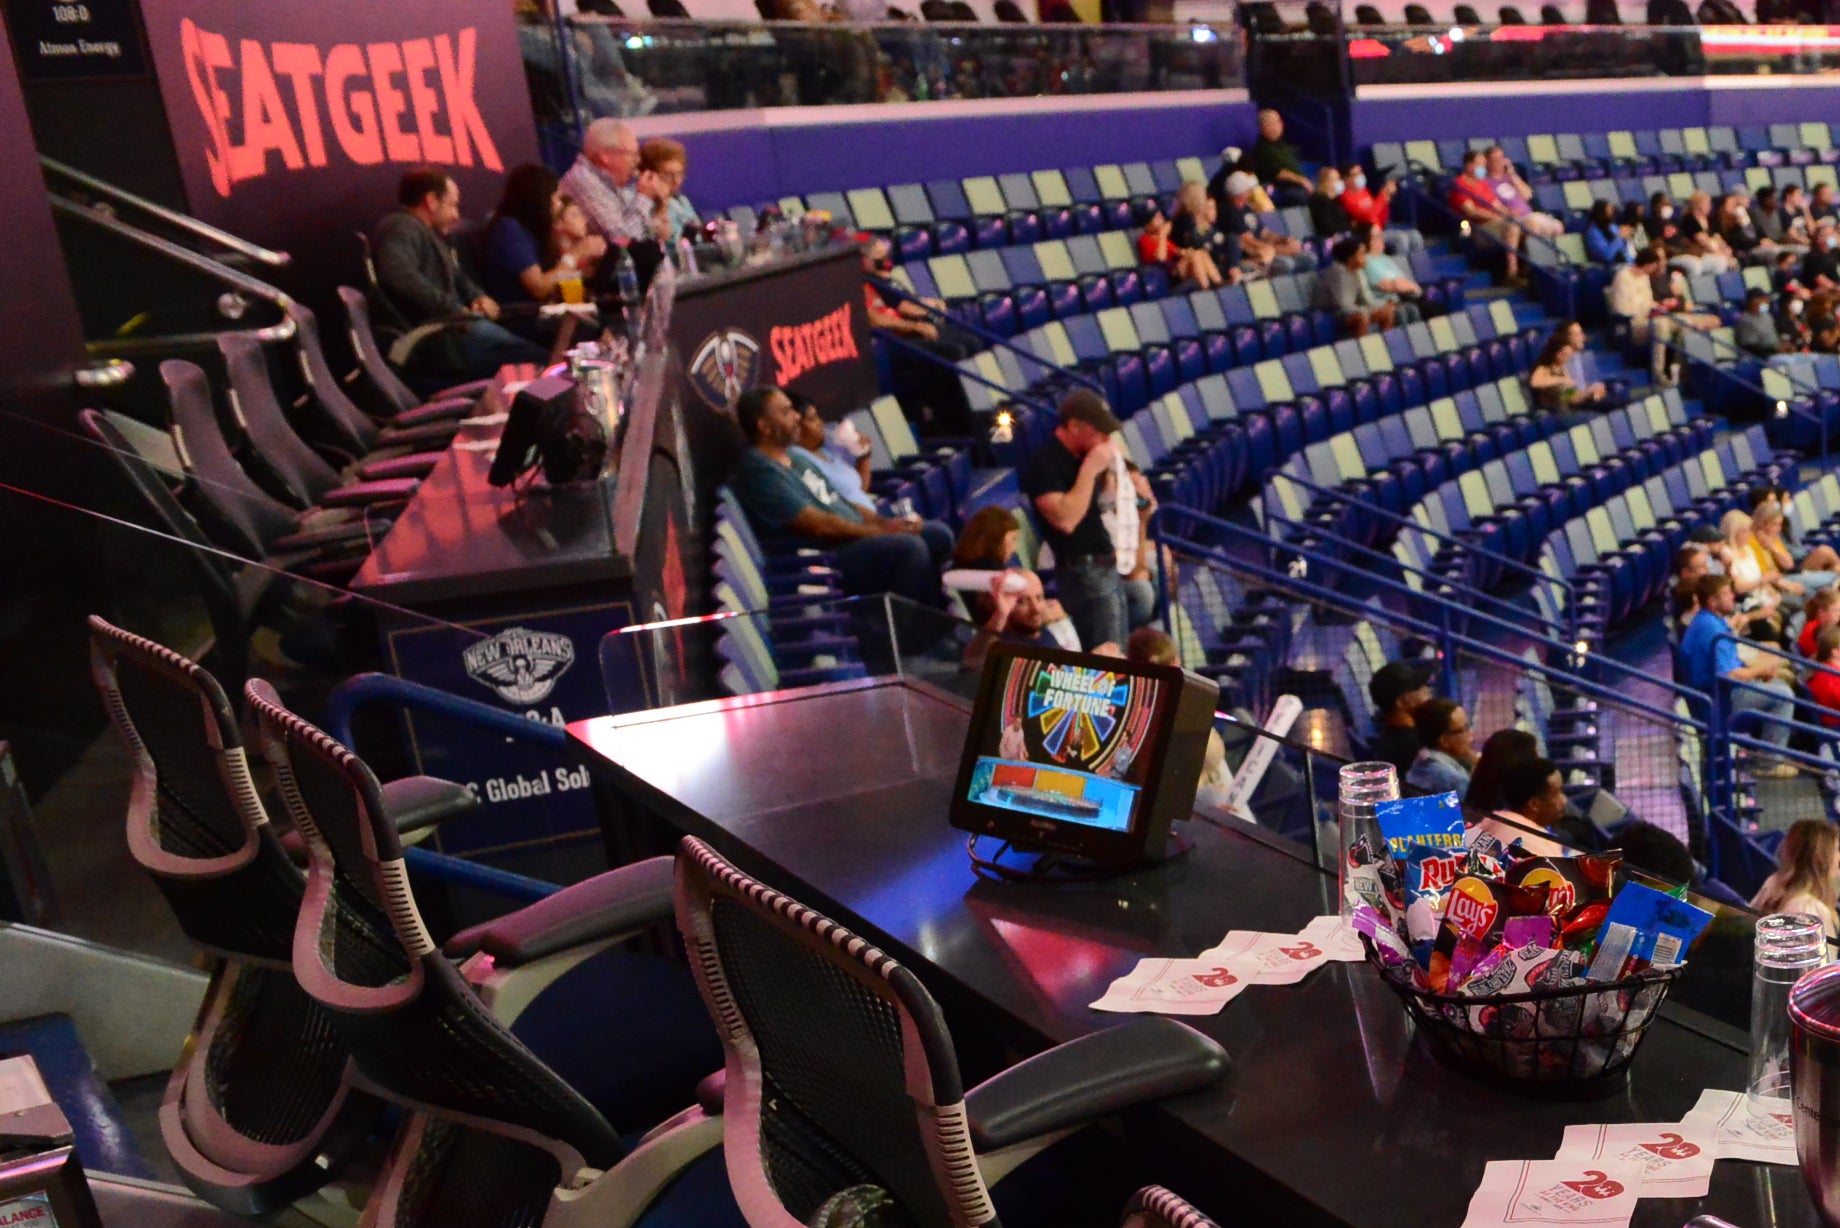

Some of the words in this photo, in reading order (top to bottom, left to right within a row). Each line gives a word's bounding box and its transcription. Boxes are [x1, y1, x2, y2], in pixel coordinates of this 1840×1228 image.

[180, 17, 504, 197] SEATGEEK
[770, 303, 859, 386] SEATGEEK
[466, 640, 501, 674] NEW
[505, 635, 572, 662] ORLEANS
[1050, 669, 1095, 694] WHEEL
[1097, 678, 1116, 698] OF
[1043, 688, 1111, 718] FORTUNE
[486, 770, 551, 804] Global
[1449, 889, 1493, 935] Lay's
[1638, 1133, 1701, 1160] 20
[1549, 1184, 1594, 1207] YEARS
[1560, 1170, 1625, 1199] 20
